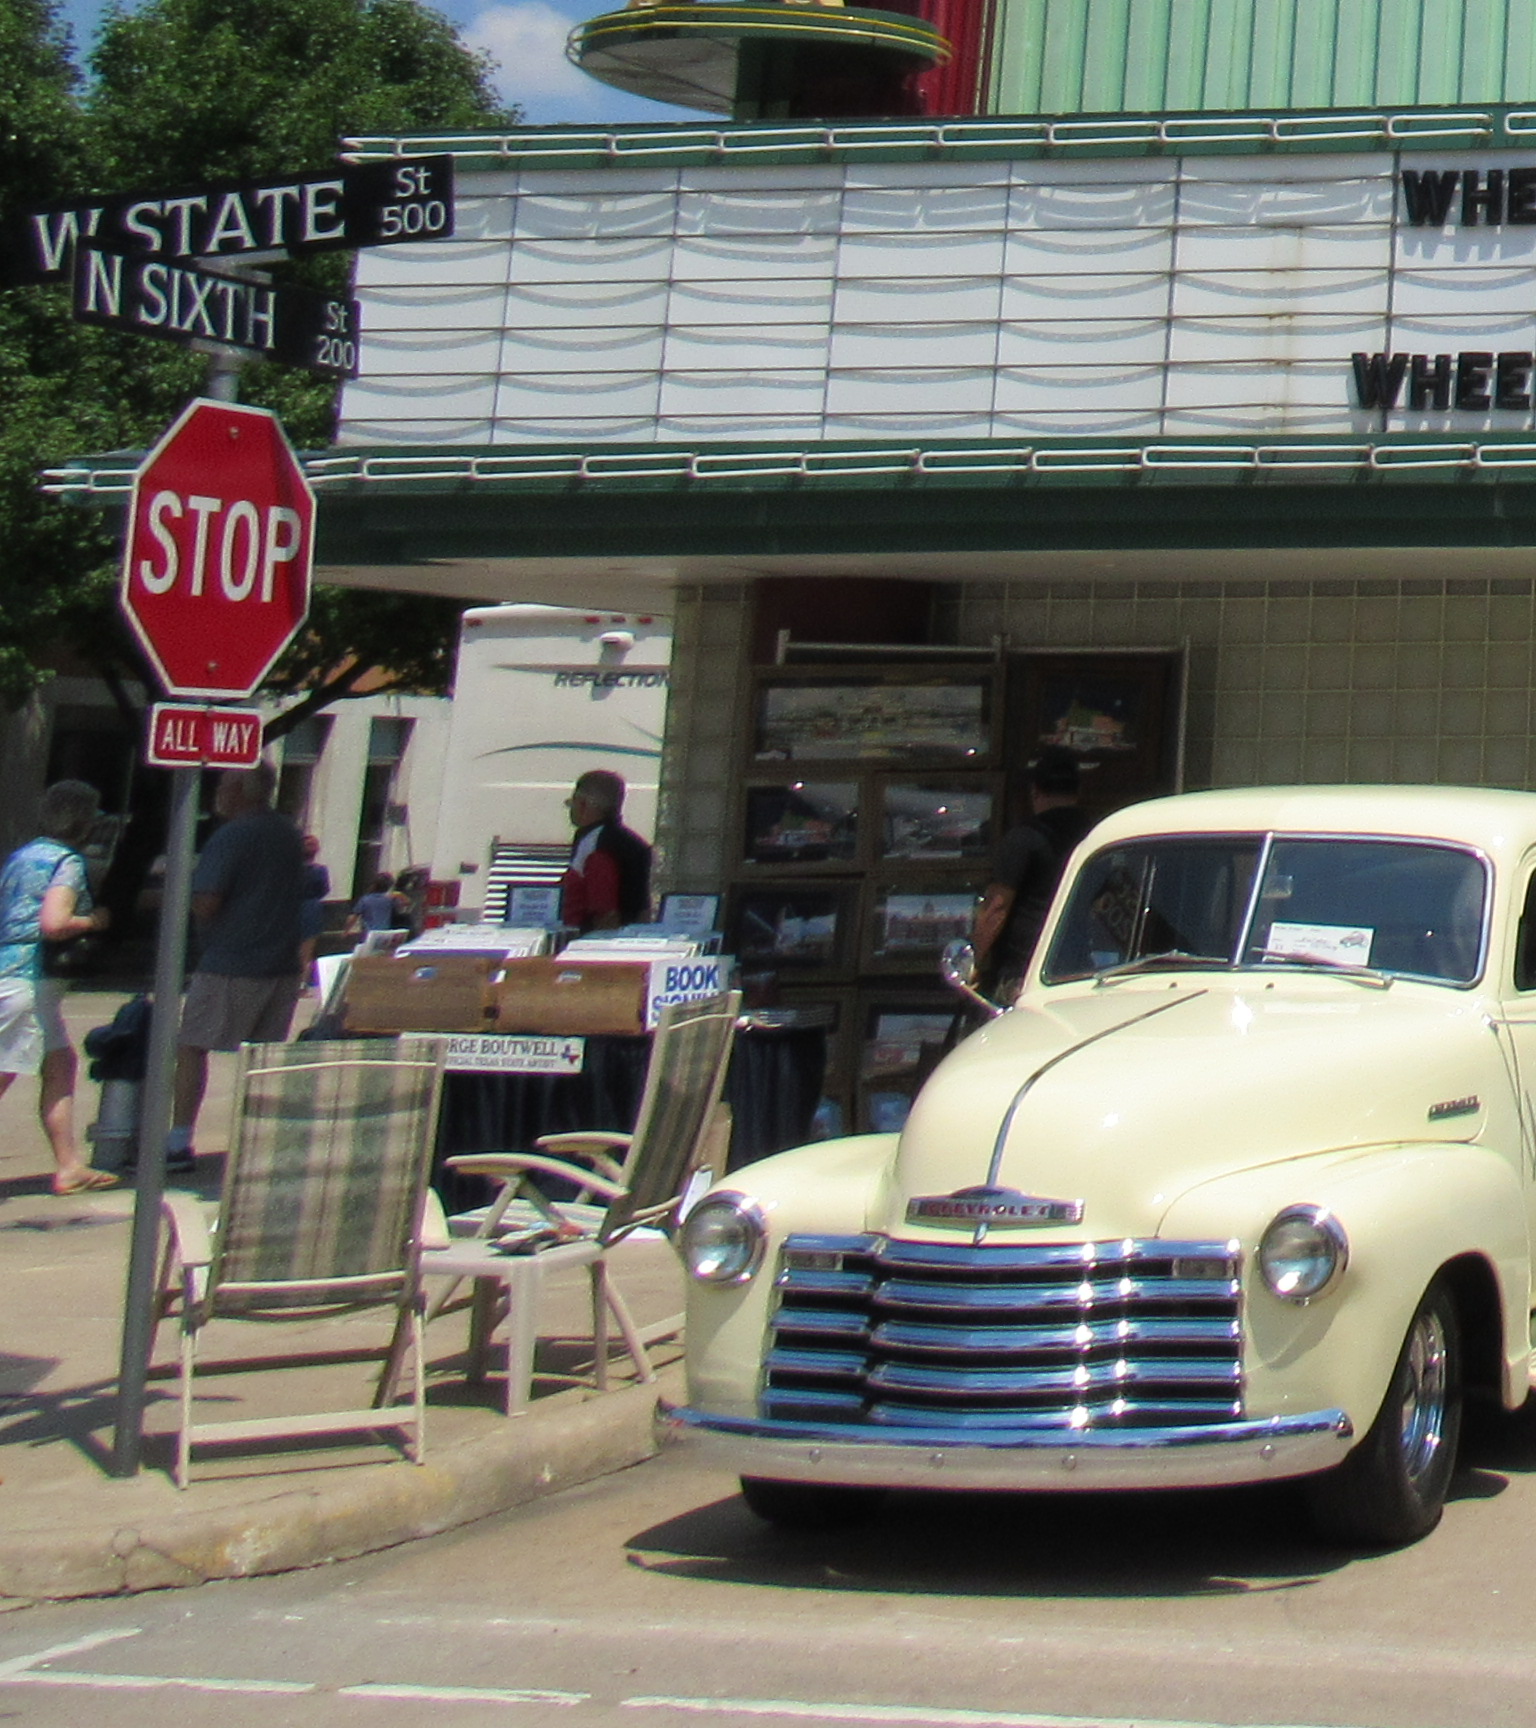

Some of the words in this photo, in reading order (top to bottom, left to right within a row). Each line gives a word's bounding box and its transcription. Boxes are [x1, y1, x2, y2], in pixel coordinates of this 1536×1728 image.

[396, 165, 431, 199] St
[125, 179, 346, 257] STATE
[379, 200, 446, 238] 500
[86, 248, 123, 316] N
[138, 262, 277, 349] SIXTH
[326, 300, 349, 332] St
[316, 335, 356, 371] 200
[140, 489, 301, 603] STOP
[160, 719, 199, 752] ALL
[212, 721, 254, 755] WAY
[665, 963, 720, 992] BOOK
[480, 1038, 558, 1057] BOUTWELL
